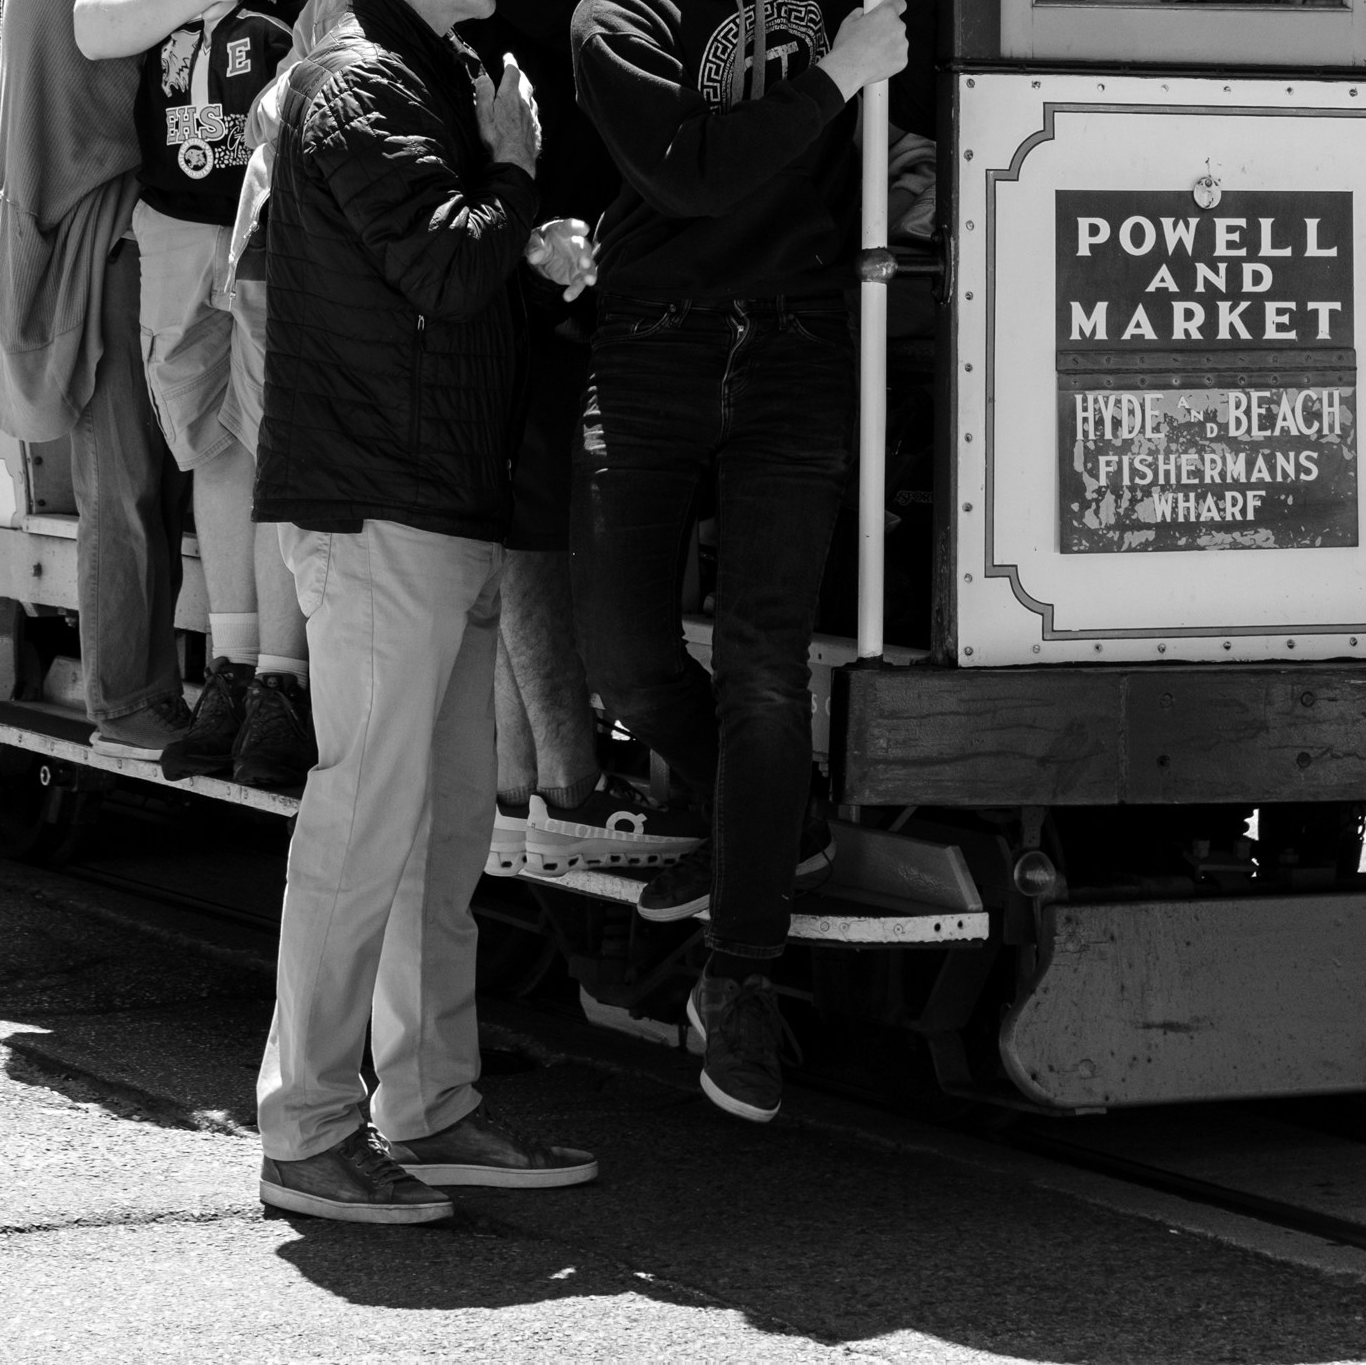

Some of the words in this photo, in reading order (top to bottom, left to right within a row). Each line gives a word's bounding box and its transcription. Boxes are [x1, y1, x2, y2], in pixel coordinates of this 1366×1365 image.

[226, 38, 251, 77] E
[166, 103, 226, 146] EHS
[1076, 217, 1338, 257] POWELL
[1146, 263, 1273, 293] AND
[1069, 301, 1342, 340] MARKET
[1075, 394, 1164, 440] HYDE
[1177, 396, 1219, 438] AND
[1227, 390, 1341, 436] BEACH
[1098, 451, 1319, 487] FISHERMANS
[1153, 490, 1266, 522] WHARF
